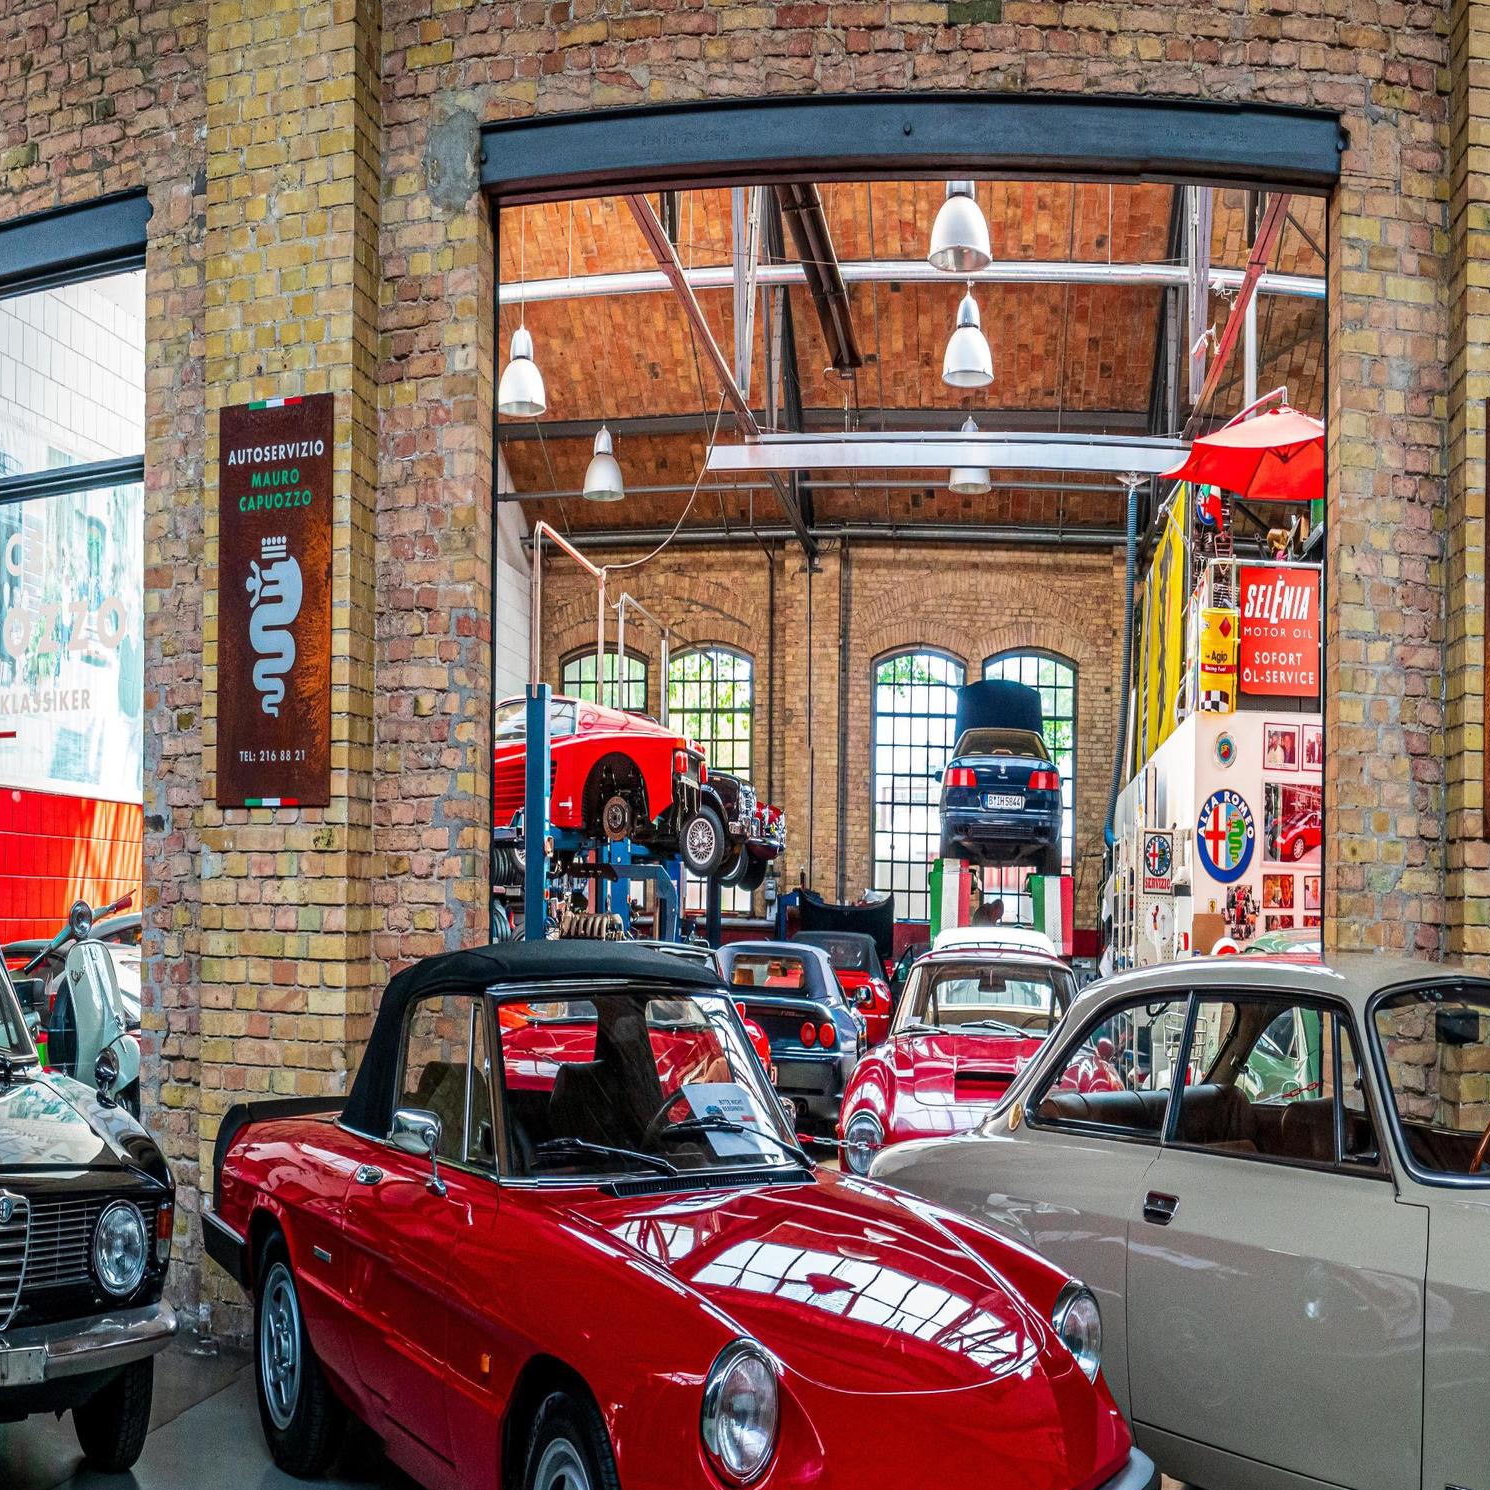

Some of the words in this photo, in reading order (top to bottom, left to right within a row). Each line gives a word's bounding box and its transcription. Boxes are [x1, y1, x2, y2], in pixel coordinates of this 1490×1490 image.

[228, 439, 325, 467] AUTOSERVIZIO
[251, 468, 300, 489] MAURO
[239, 489, 313, 513] CAPUOZZO
[1244, 627, 1287, 638] MOTOR
[1293, 628, 1314, 640] OIL
[1211, 650, 1228, 664] Agip
[1254, 651, 1303, 666] SOFORT
[1242, 666, 1315, 685] ÖL-SERVICE
[0, 689, 92, 716] KLASSIKER
[239, 750, 256, 762] TEL:
[259, 750, 277, 762] 216
[280, 750, 291, 761] 88
[295, 749, 306, 761] 21
[1197, 795, 1220, 839] ALFA
[1223, 791, 1255, 840] ROMEO
